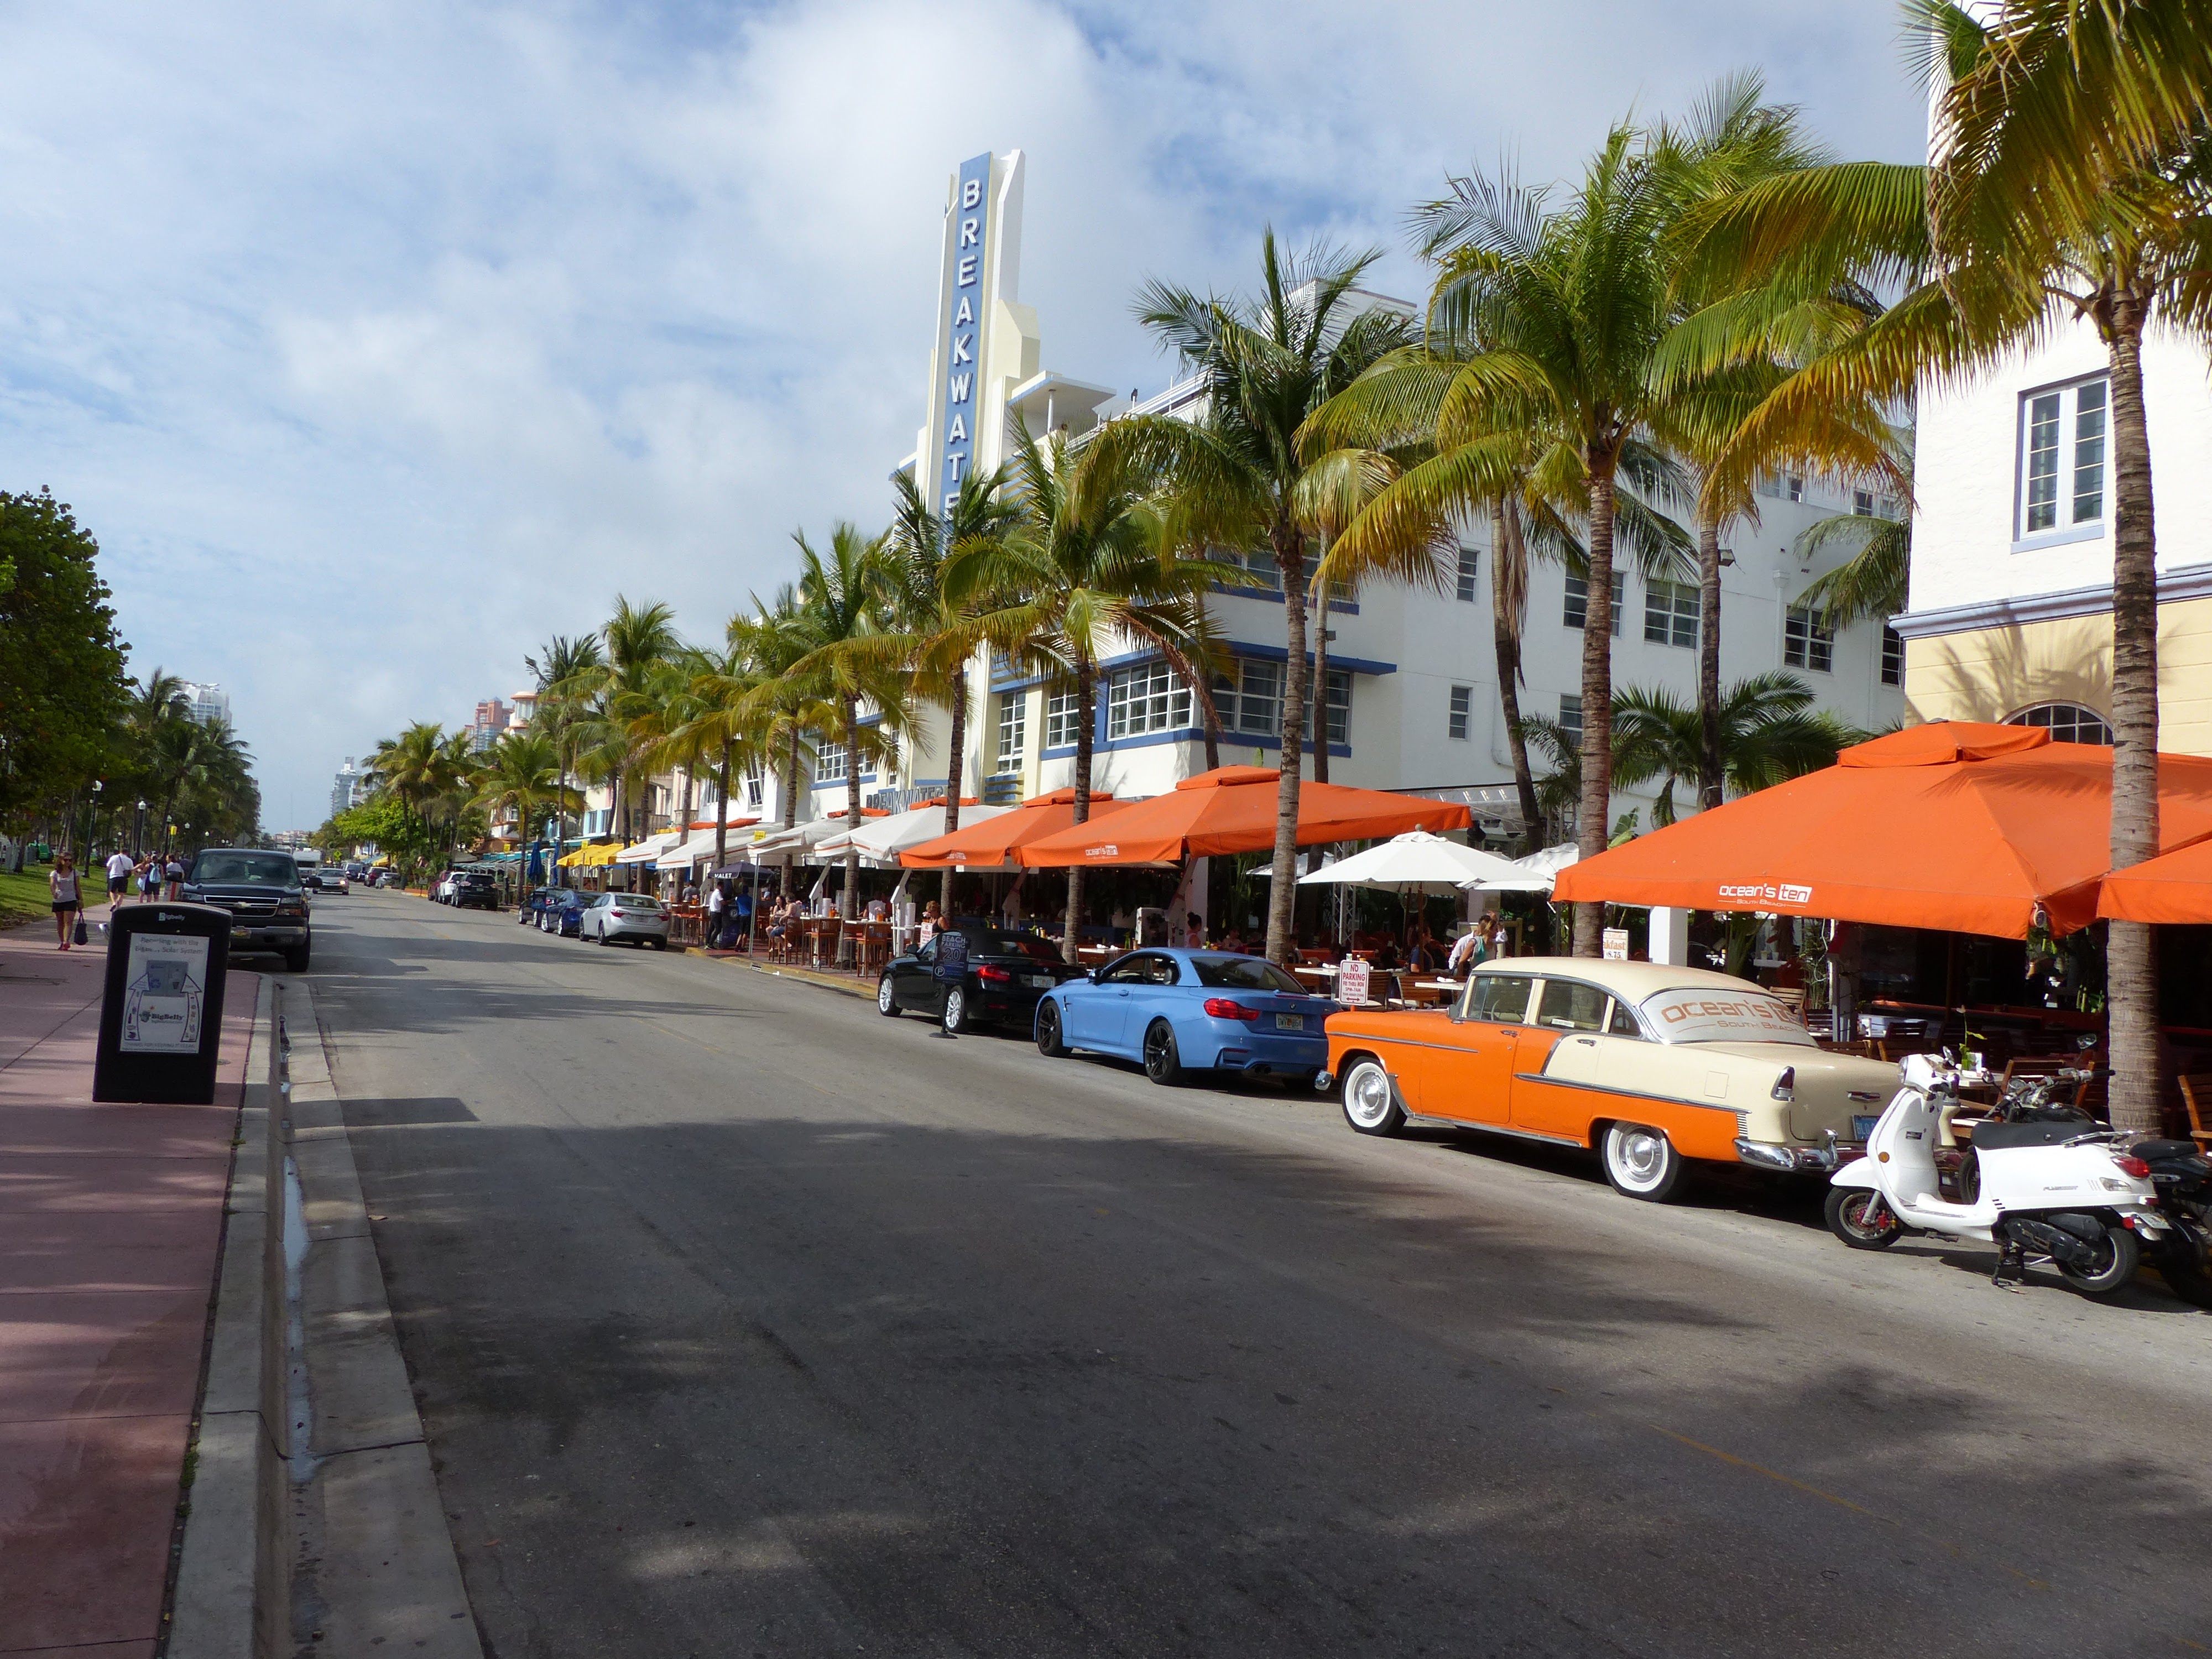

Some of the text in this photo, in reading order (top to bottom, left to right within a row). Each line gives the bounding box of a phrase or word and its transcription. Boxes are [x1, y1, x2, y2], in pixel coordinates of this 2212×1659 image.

[943, 179, 982, 521] BREAKWATE
[1719, 883, 1810, 902] ocean's ten
[942, 935, 966, 943] BEACH
[1604, 940, 1625, 950] akfast
[1343, 973, 1365, 981] PARKING
[1661, 1000, 1773, 1023] ocean's
[1761, 1022, 1798, 1032] BEACH
